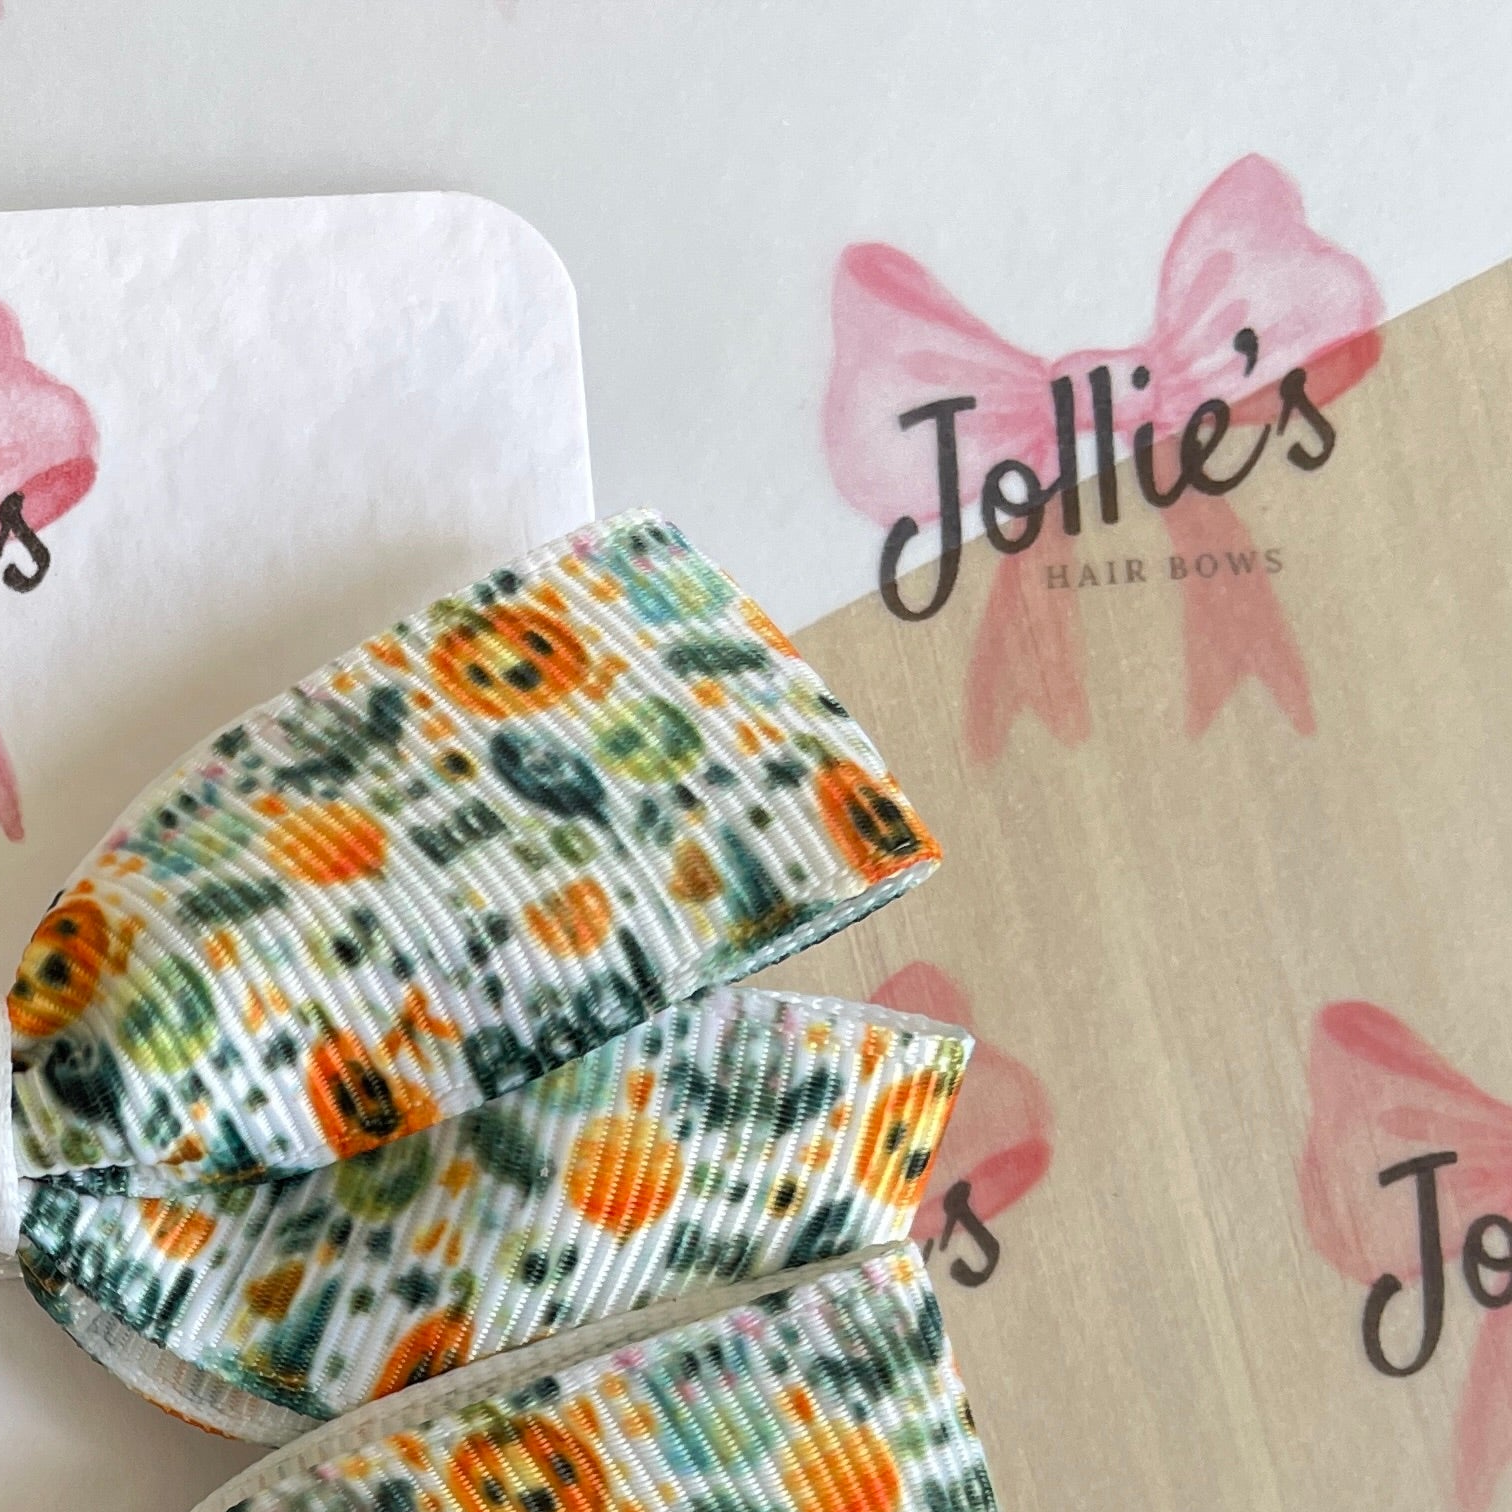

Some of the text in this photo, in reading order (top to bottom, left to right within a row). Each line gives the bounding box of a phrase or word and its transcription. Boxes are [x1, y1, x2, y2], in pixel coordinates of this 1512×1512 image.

[879, 328, 1337, 622] Jollie's
[1046, 548, 1284, 590] HAIR BOWS
